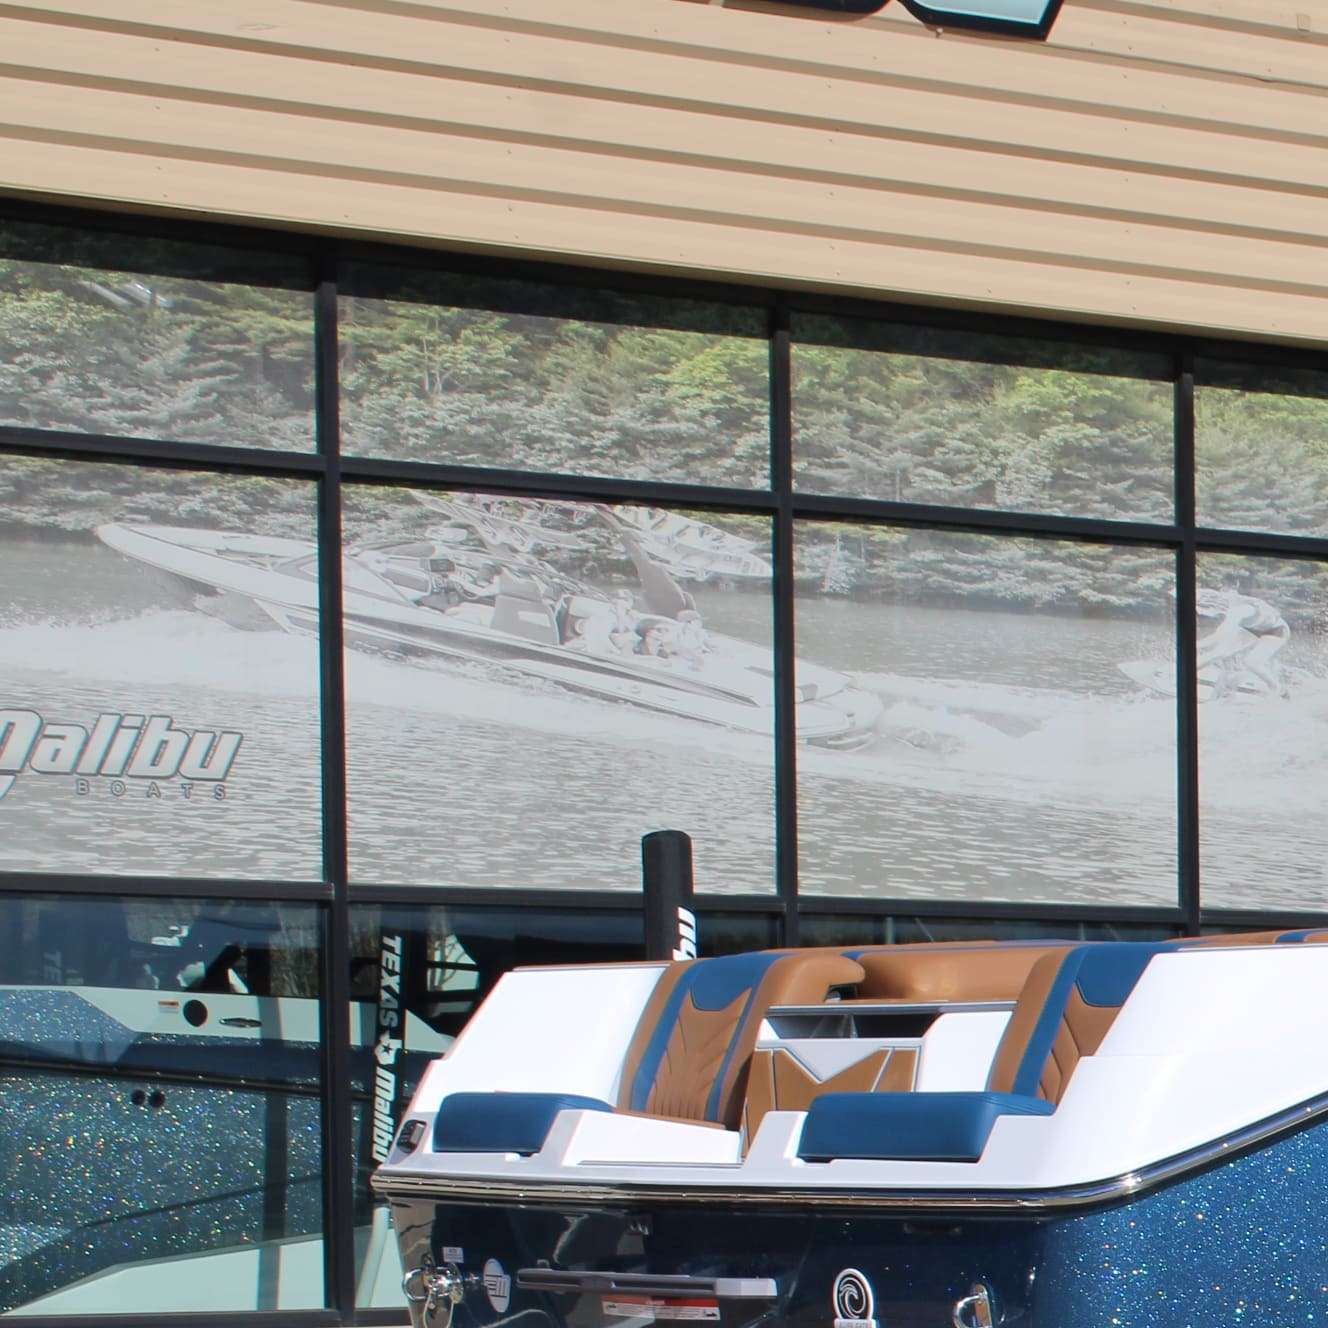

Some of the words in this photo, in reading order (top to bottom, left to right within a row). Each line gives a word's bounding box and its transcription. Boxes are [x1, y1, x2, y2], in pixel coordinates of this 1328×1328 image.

[75, 778, 227, 801] BOATS
[379, 934, 403, 1029] TEXAS
[371, 1065, 396, 1164] Malibu
